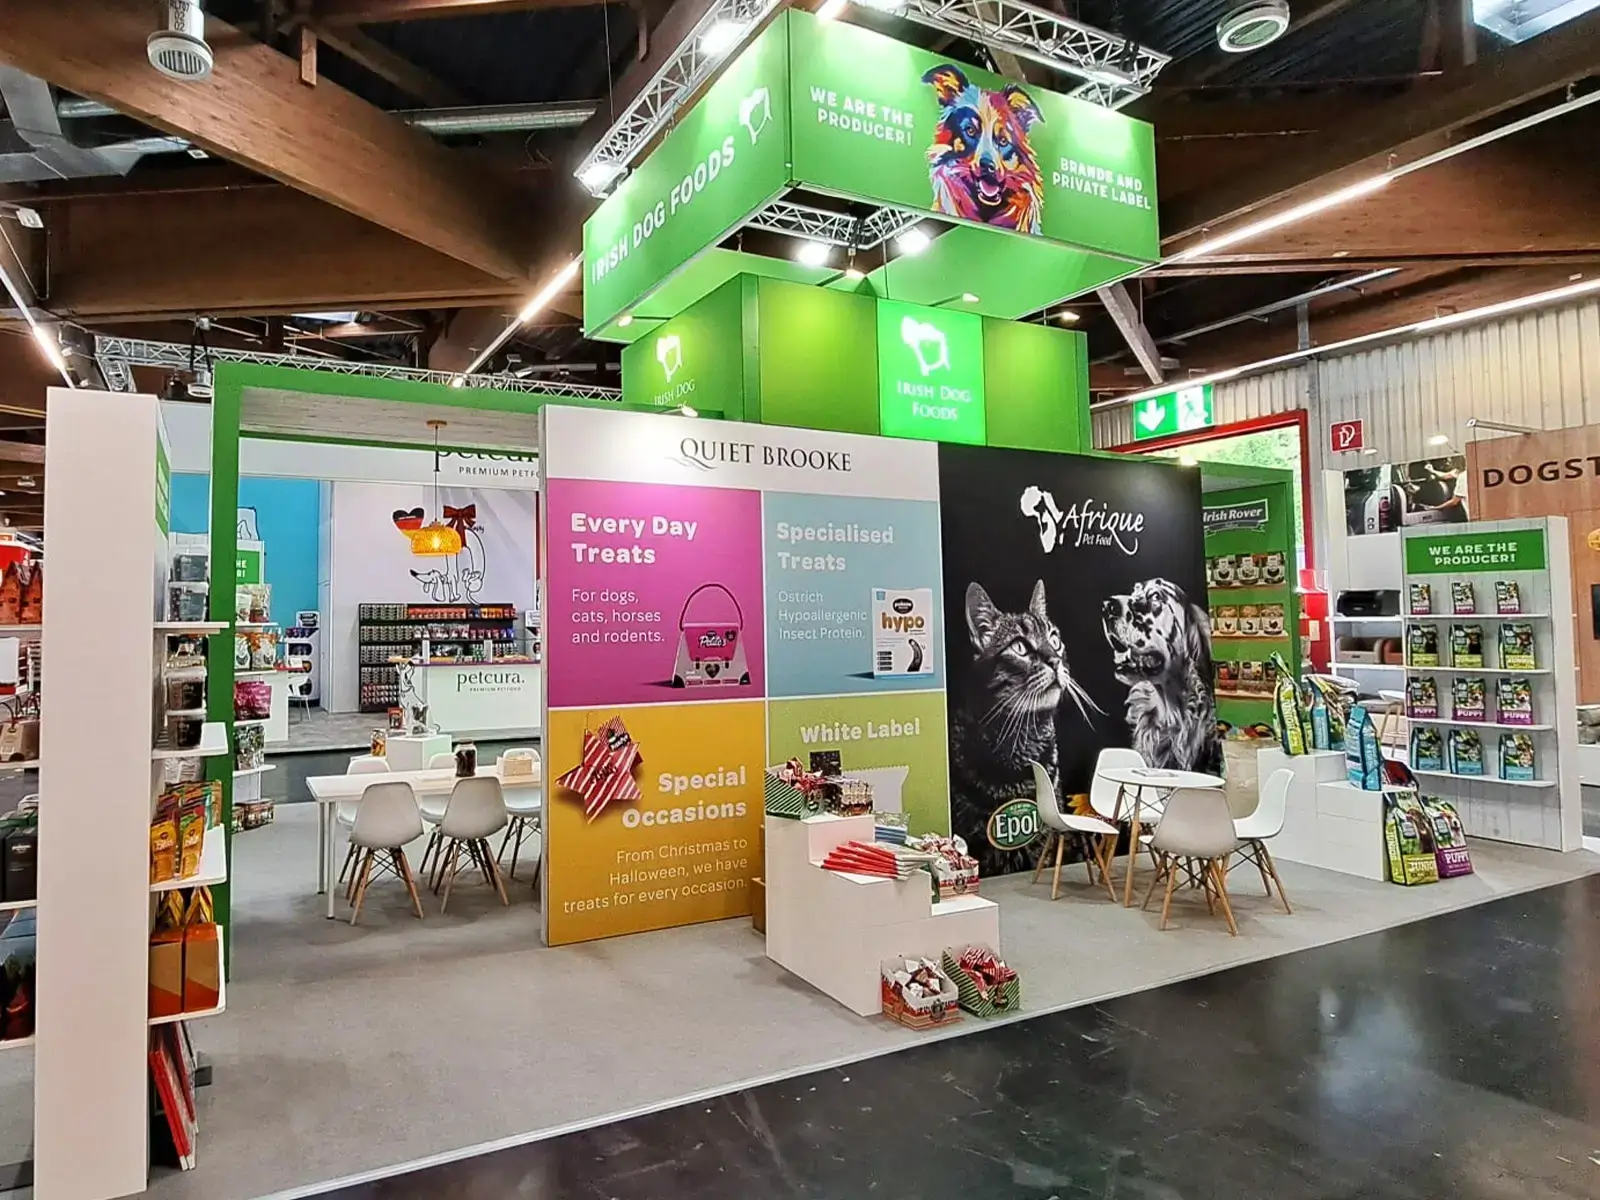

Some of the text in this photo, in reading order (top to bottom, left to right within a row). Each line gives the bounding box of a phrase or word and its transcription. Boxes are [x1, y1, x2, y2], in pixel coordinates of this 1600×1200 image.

[809, 84, 915, 128] WE ARE THE
[817, 107, 913, 147] PRODUCER!
[1060, 157, 1143, 191] BRANDS AND
[1052, 172, 1151, 210] PRIVATE LABEL
[591, 135, 735, 286] IRISH DOG FOODS
[672, 437, 852, 472] QUIET BROOKE
[458, 466, 509, 477] PREMIUM
[570, 512, 698, 541] Every Day
[1063, 498, 1145, 556] Afrique
[1202, 507, 1263, 524] Irish Rover
[776, 521, 895, 545] Specialised
[1082, 533, 1112, 547] Pet Food
[570, 542, 656, 565] Treats
[777, 550, 846, 571] Treats
[1428, 542, 1518, 556] WE ARE THE
[1434, 554, 1516, 566] PRODUCER!
[571, 588, 639, 606] For dogs,
[778, 590, 823, 604] Ostrich
[571, 607, 661, 625] cats, horses
[778, 608, 868, 625] Hypoallergenic
[882, 612, 925, 633] hypo
[571, 628, 665, 644] and rodents.
[778, 626, 866, 641] Insect Protein.
[457, 671, 525, 692] petcura.
[1457, 709, 1483, 717] PUPPY
[800, 717, 921, 745] White Label
[658, 765, 747, 797] Special
[622, 799, 748, 829] Occasions
[995, 811, 1038, 842] Epol
[617, 837, 748, 865] From Christmas to
[609, 856, 748, 887] Halloween, we have
[563, 876, 748, 914] treats for every occasion.
